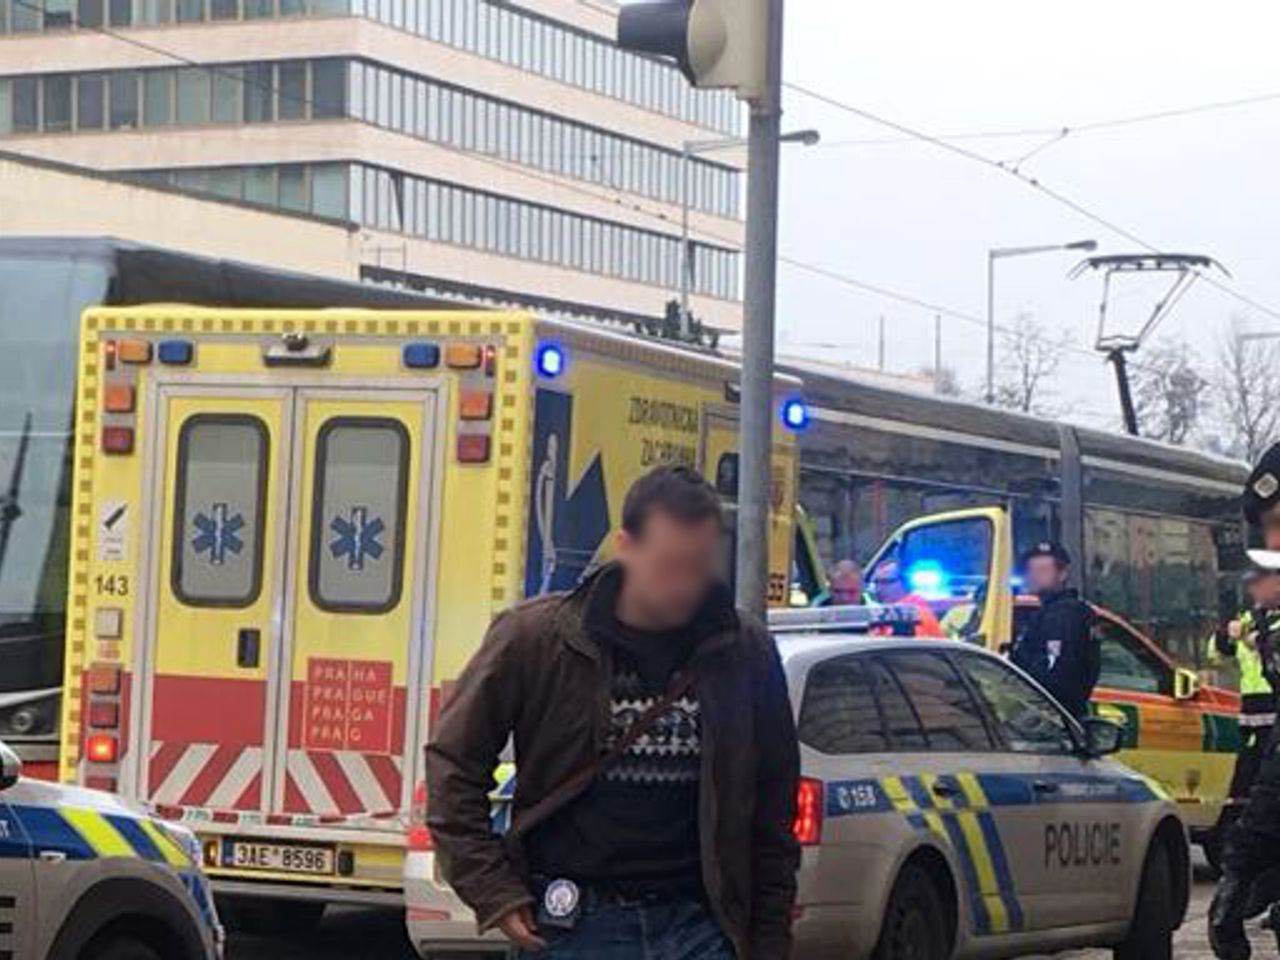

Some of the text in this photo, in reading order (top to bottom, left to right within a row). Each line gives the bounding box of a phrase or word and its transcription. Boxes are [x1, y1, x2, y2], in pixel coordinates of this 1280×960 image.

[95, 573, 129, 596] 143
[237, 844, 325, 870] 3AE 8596
[1043, 821, 1122, 869] POLICIE
